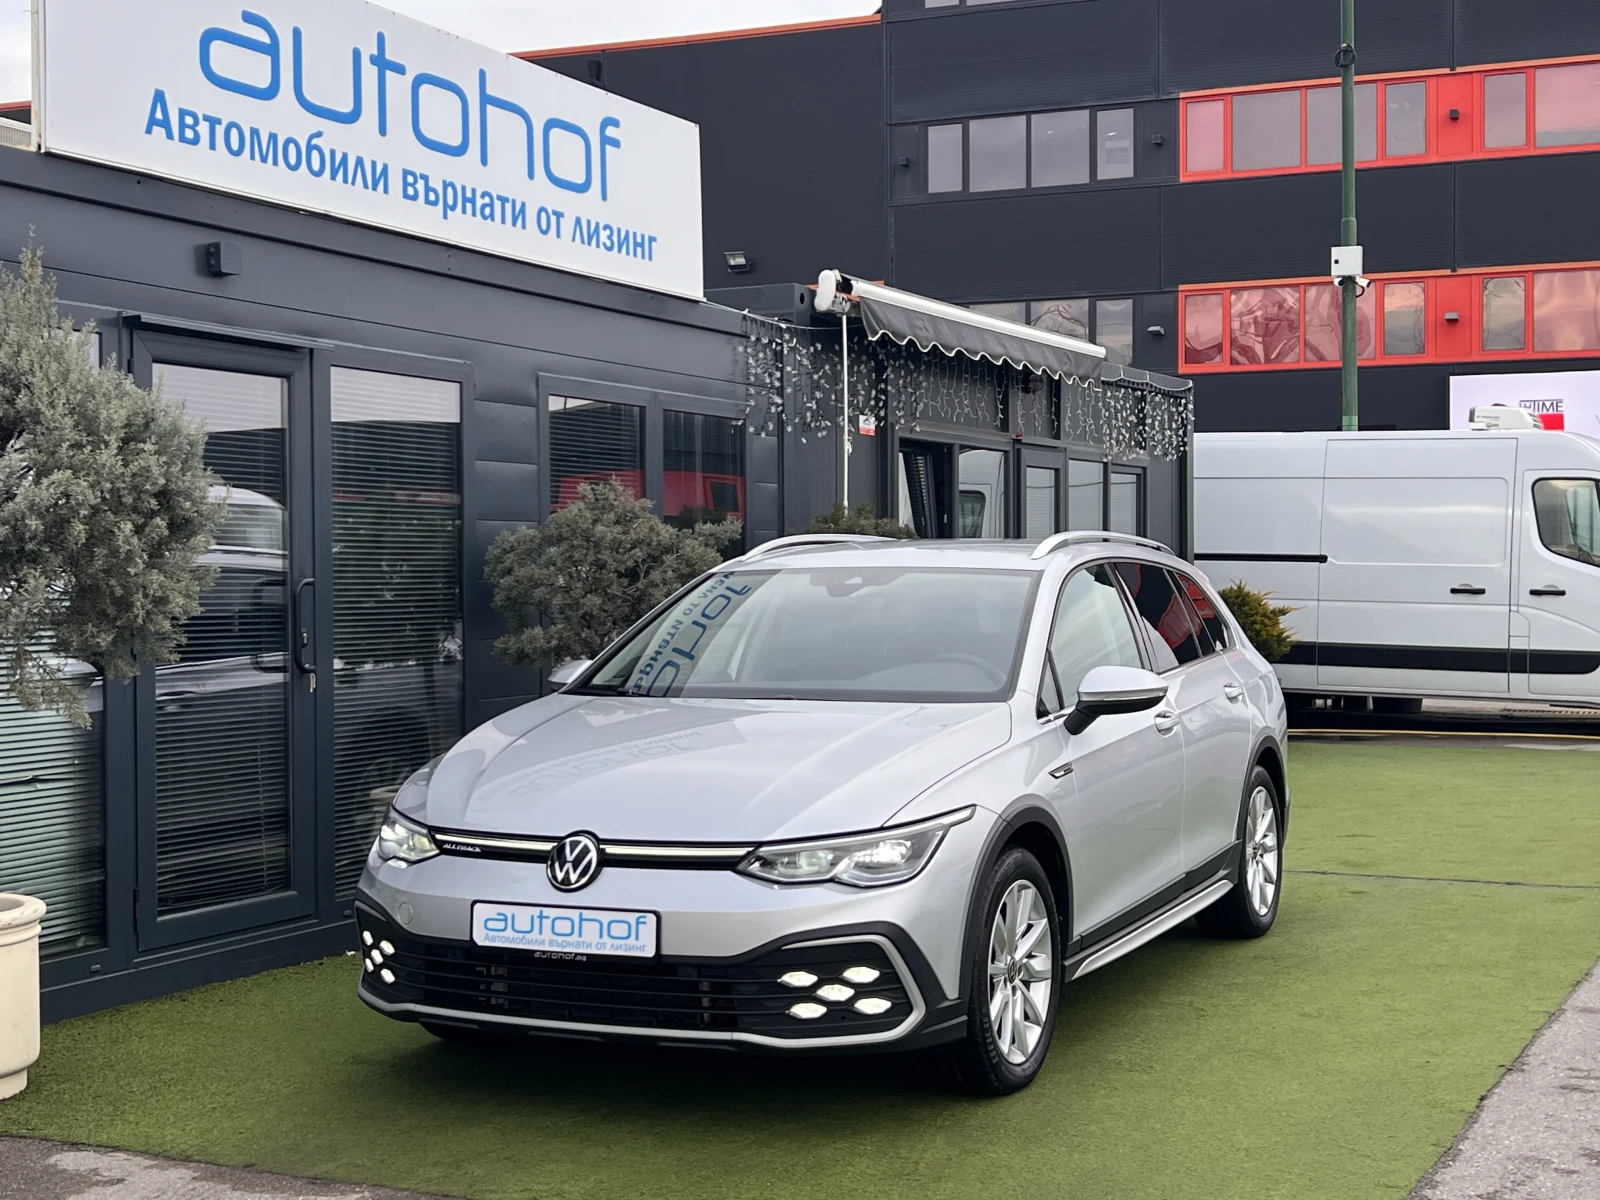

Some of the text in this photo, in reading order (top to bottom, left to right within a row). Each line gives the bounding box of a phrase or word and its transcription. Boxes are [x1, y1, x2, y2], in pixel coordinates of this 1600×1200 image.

[198, 9, 621, 202] autohof
[144, 87, 657, 261] Автомобили върнати от лизинг
[483, 910, 648, 941] autohof
[484, 932, 648, 954] Автомобили върнати от лизинг
